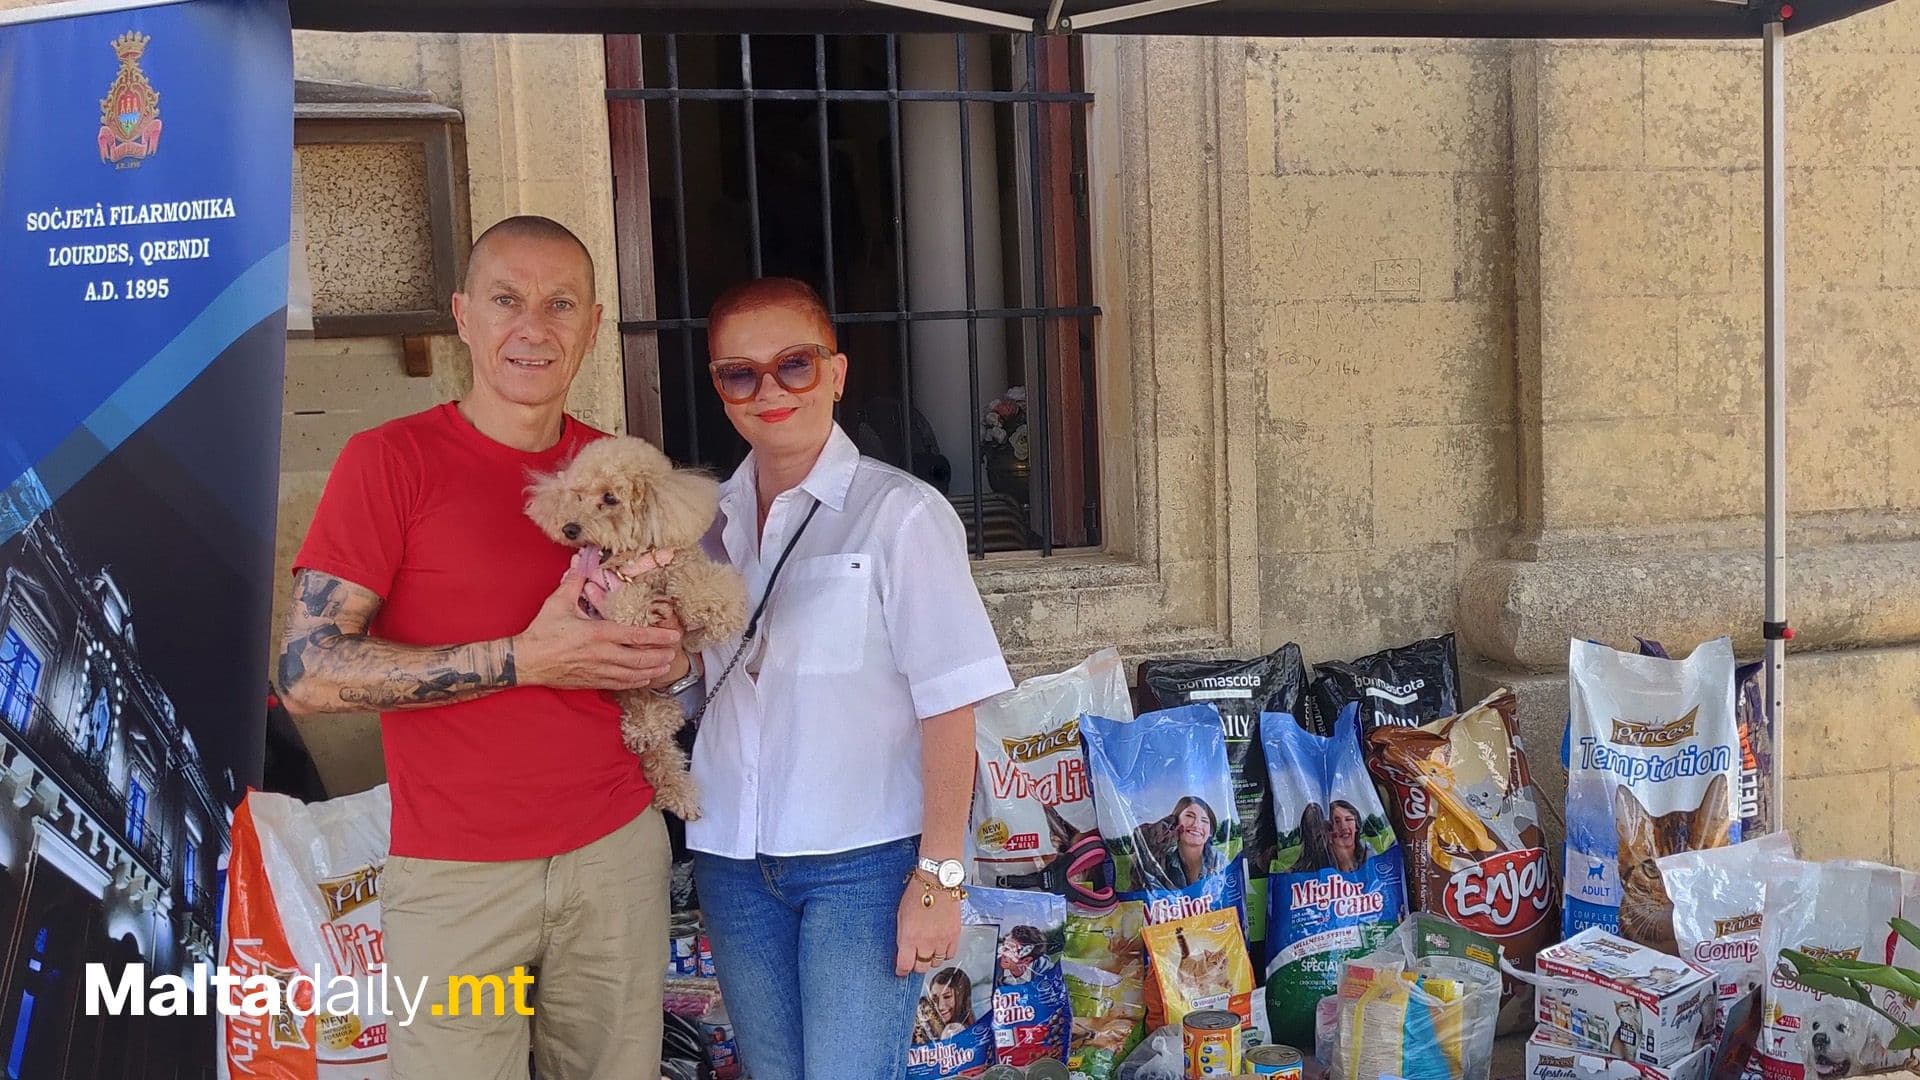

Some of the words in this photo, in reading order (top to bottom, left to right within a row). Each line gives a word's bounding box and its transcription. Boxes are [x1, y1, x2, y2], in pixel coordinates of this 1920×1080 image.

[26, 203, 105, 231] SOĊJETÀ
[109, 197, 236, 226] FILARMONIKA
[49, 243, 135, 267] LOURDES,
[139, 238, 210, 266] QRENDI
[84, 281, 119, 302] A.D.
[125, 279, 170, 300] 1895
[1176, 674, 1261, 690] bonmascota
[1617, 721, 1693, 744] Princess
[1580, 736, 1731, 787] Temptation
[331, 865, 383, 912] Pri
[1290, 874, 1364, 911] Miglior
[1450, 852, 1550, 926] Enjoy
[1582, 885, 1611, 897] ADULT
[1334, 891, 1384, 918] cane
[1574, 919, 1590, 930] CAT
[321, 1015, 349, 1028] NEW
[994, 1005, 1035, 1025] cane
[907, 1042, 957, 1068] Miglior
[940, 1048, 975, 1075] gatto
